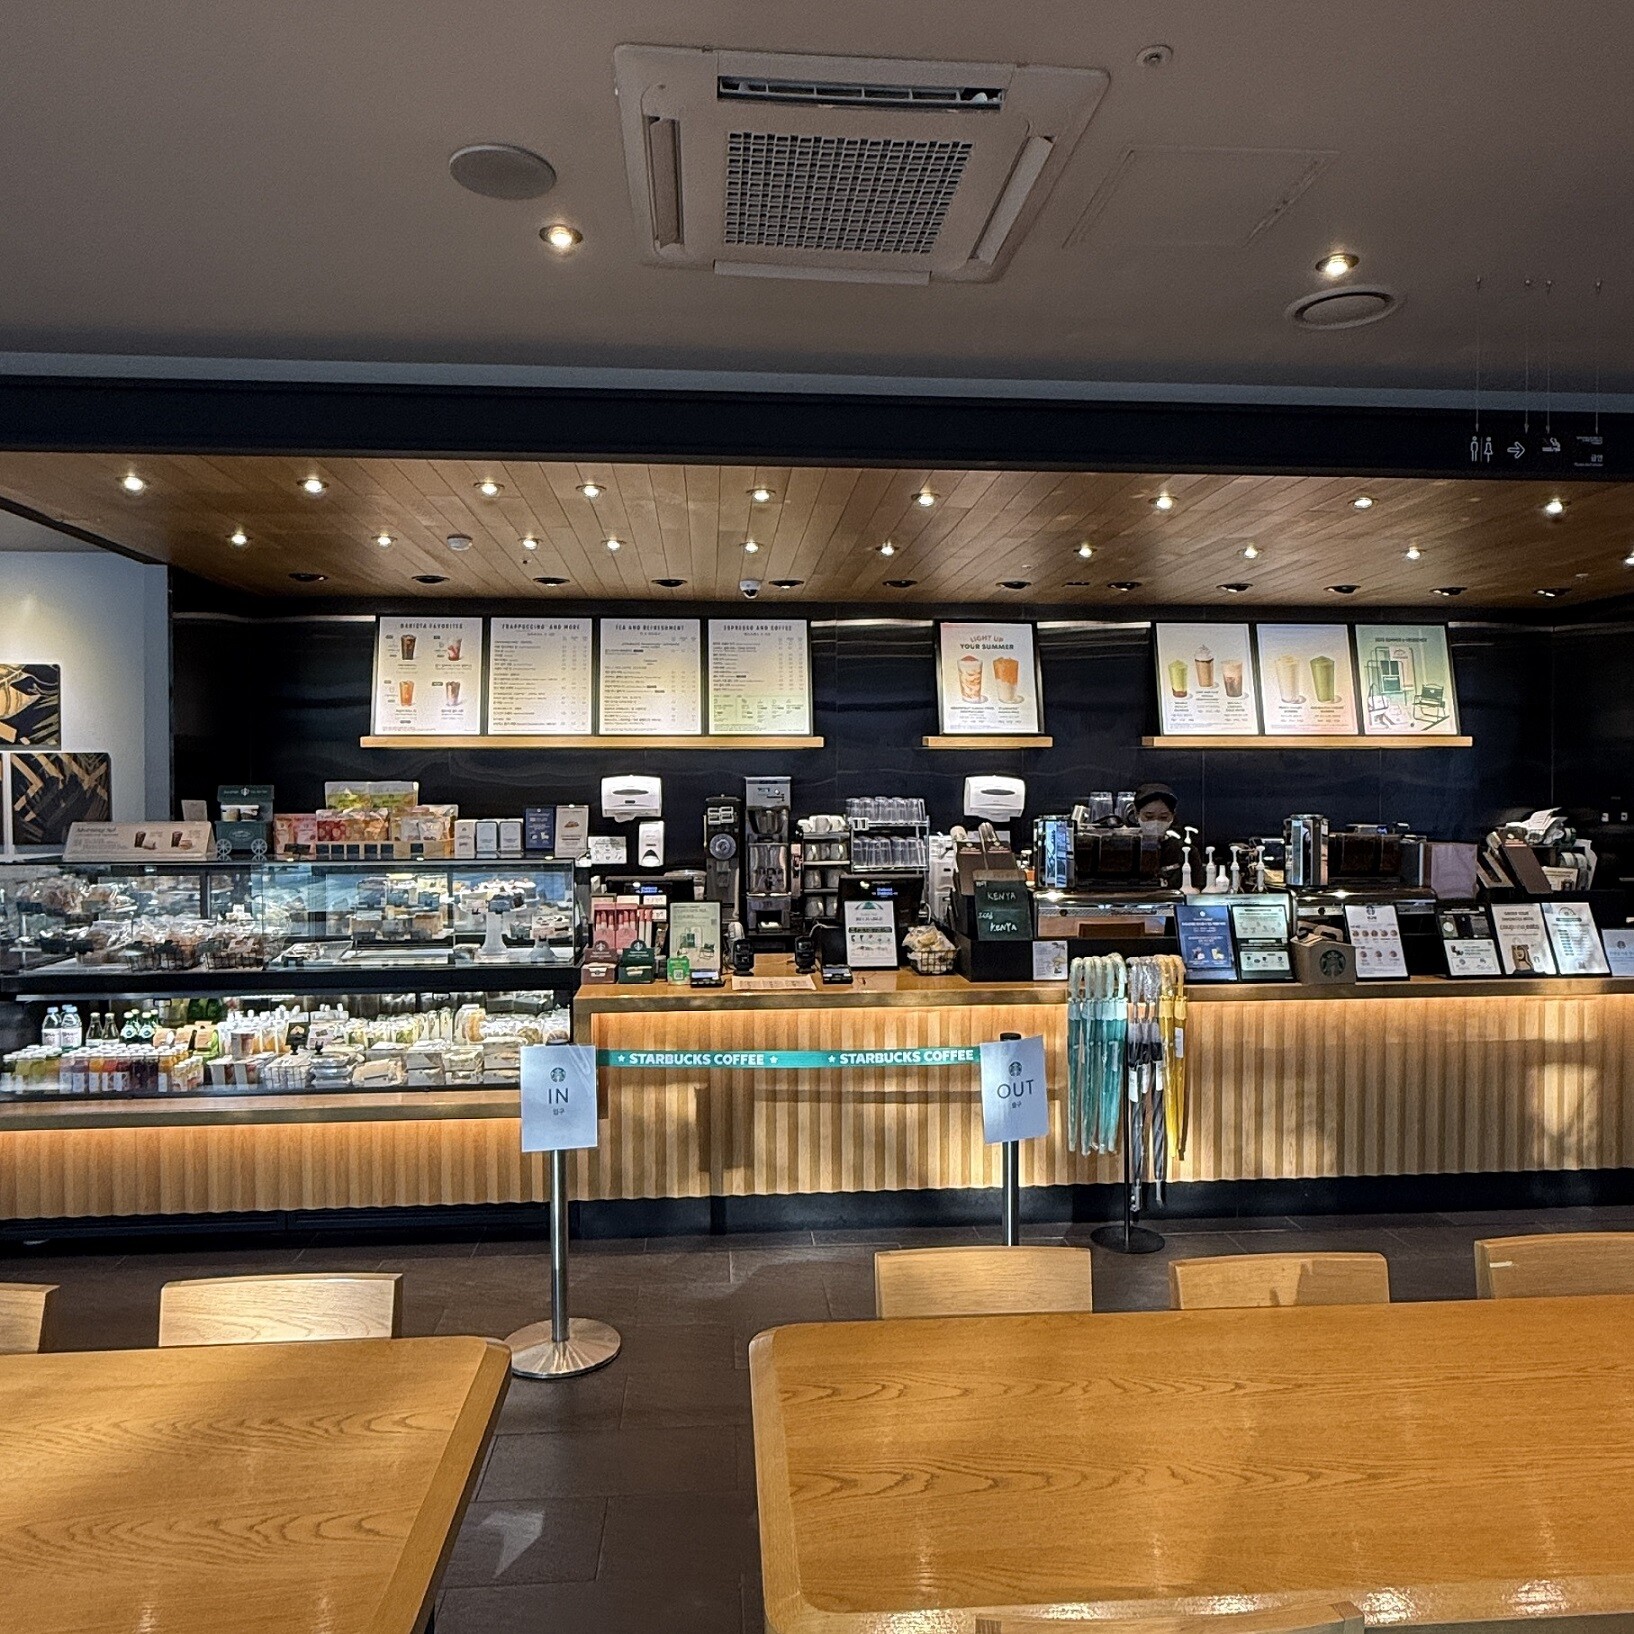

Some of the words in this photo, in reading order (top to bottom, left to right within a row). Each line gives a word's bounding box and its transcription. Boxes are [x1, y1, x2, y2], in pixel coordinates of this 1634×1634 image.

[770, 624, 792, 632] COFFEE
[970, 634, 992, 643] LIGHT
[993, 635, 1004, 643] UP
[987, 891, 1017, 901] KENYA
[629, 1053, 711, 1065] STARBUCKS
[713, 1053, 765, 1066] COFFEE
[839, 1051, 921, 1065] STARBUCKS
[923, 1049, 975, 1062] COFFEE
[548, 1087, 569, 1104] IN
[997, 1079, 1034, 1099] OUT
